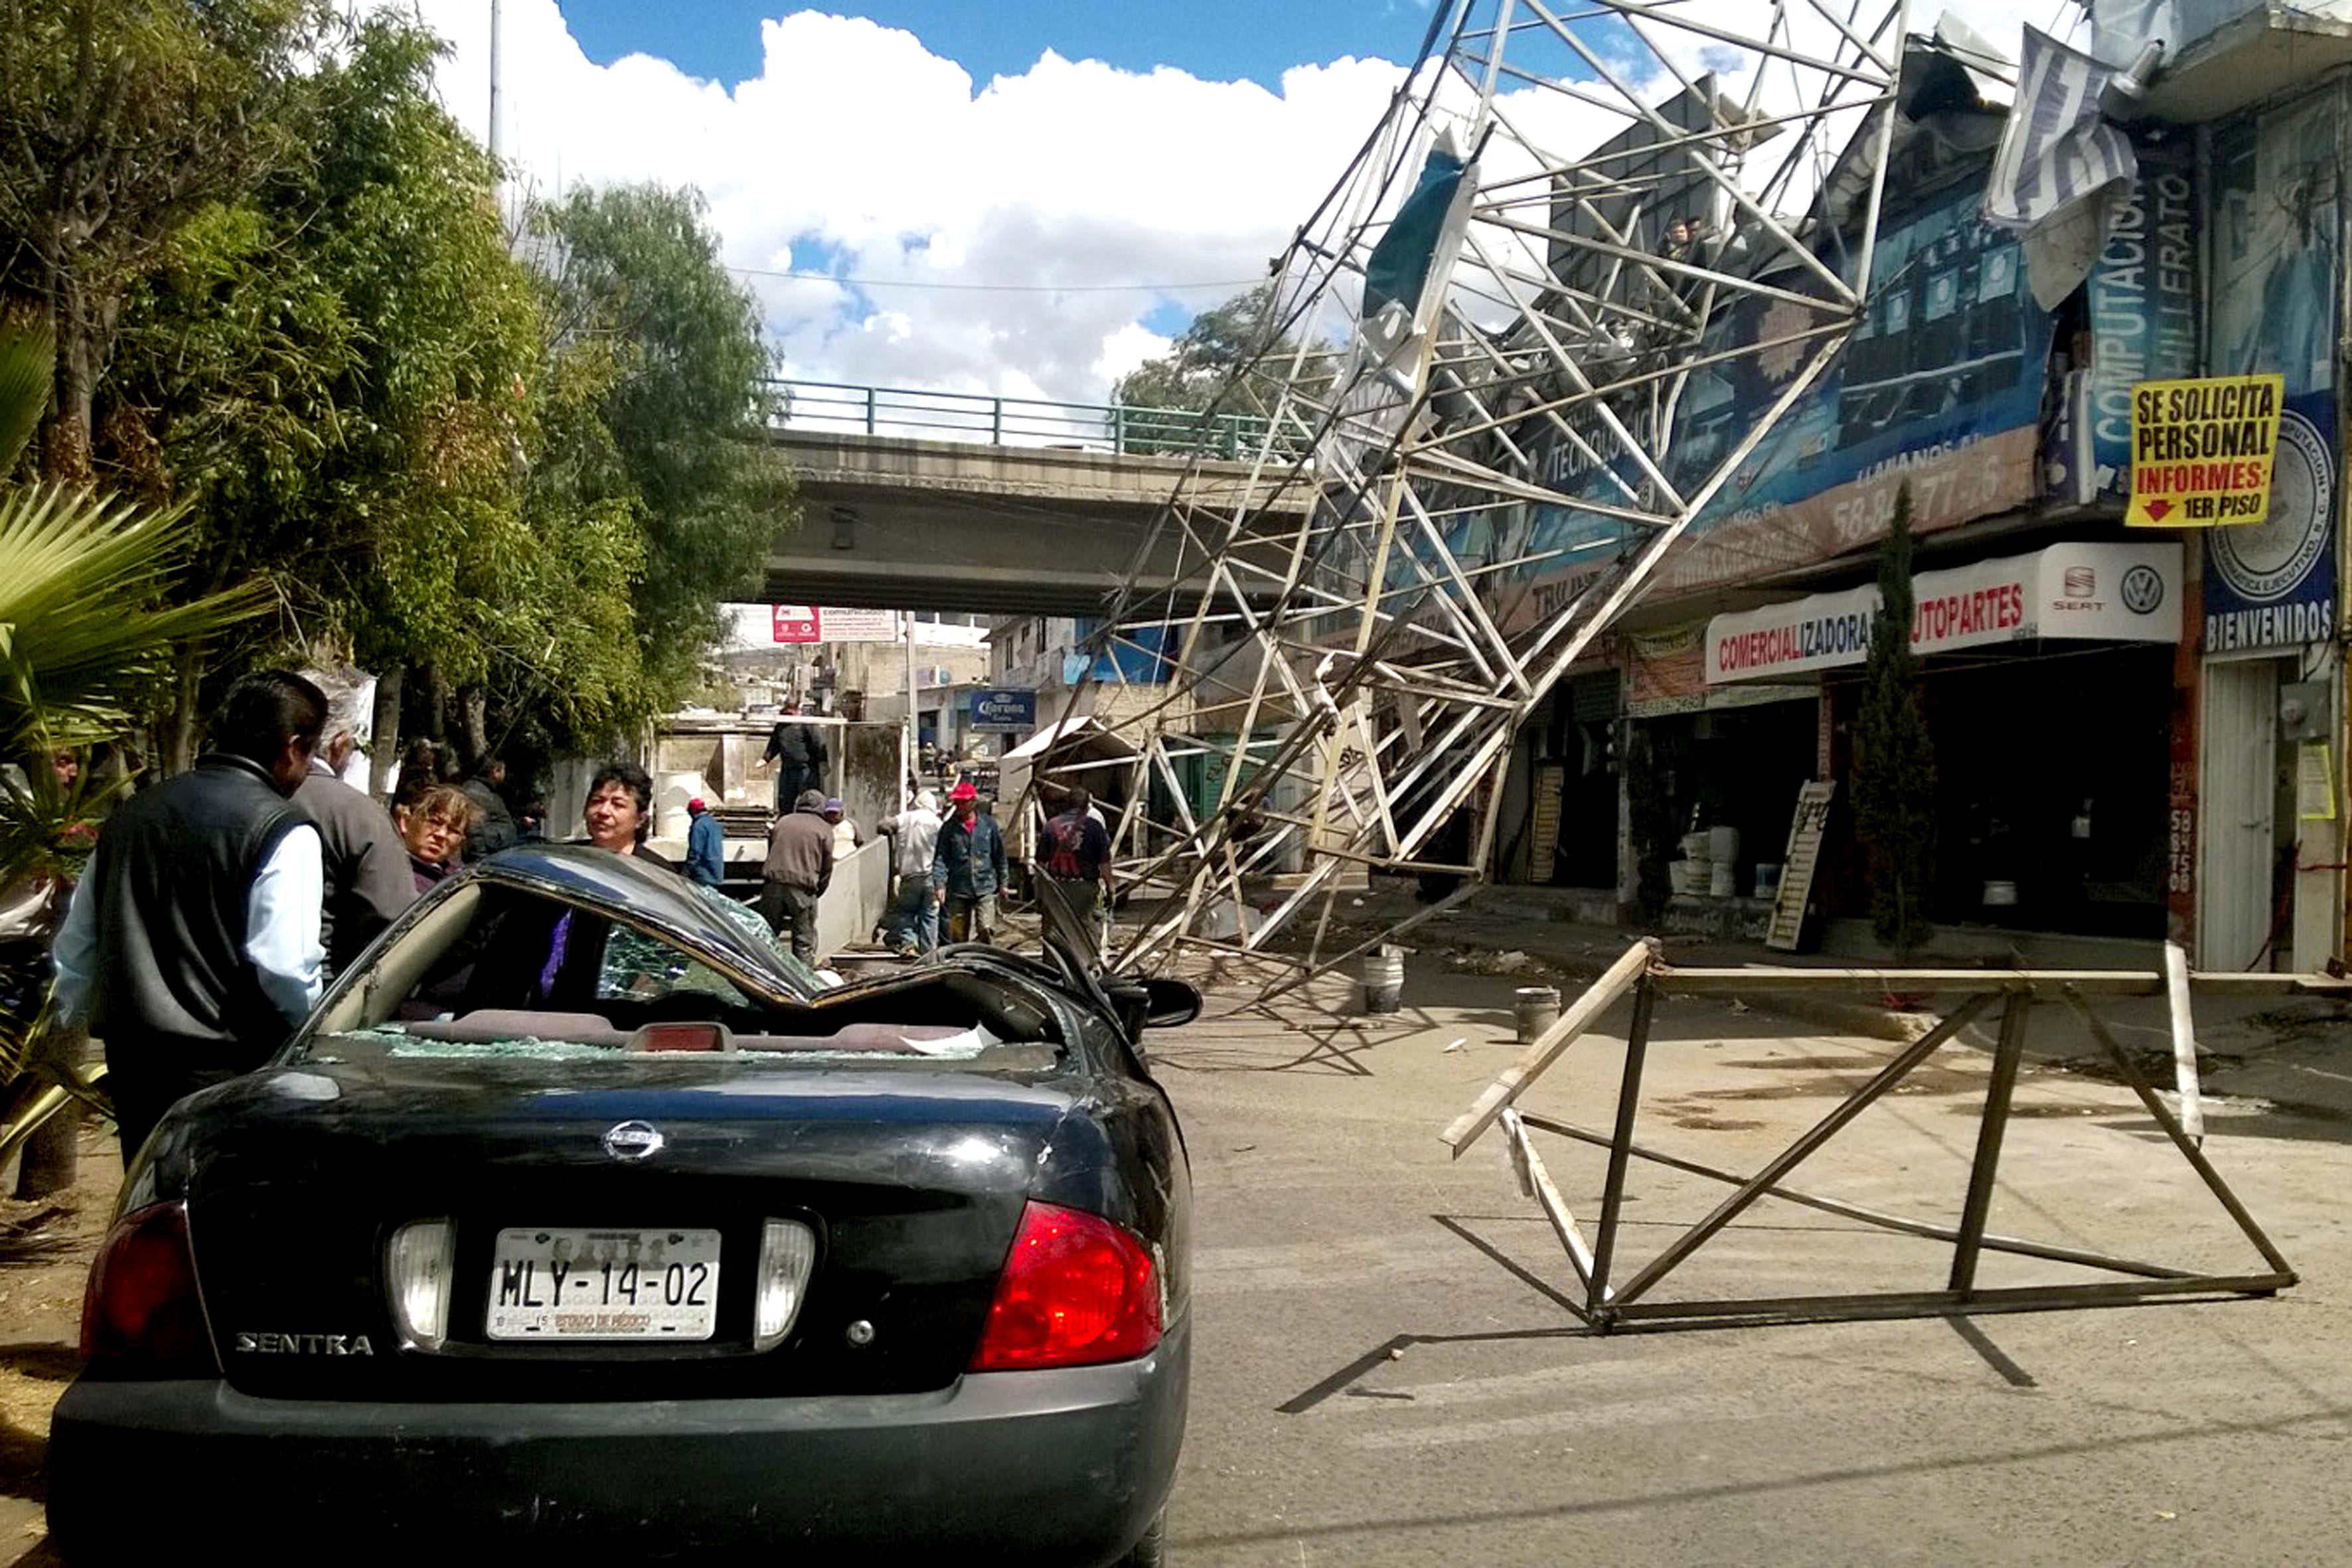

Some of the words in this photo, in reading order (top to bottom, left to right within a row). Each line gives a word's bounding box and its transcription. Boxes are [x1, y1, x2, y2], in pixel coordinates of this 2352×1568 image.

[2157, 173, 2193, 375] HILLERATO
[2137, 389, 2163, 424] SE
[2168, 384, 2274, 421] SOLICITA
[2138, 421, 2270, 461] PERSONAL
[2137, 461, 2267, 494] INFORMES:
[2184, 498, 2215, 519] 1ER
[2218, 494, 2261, 517] PISO
[1718, 611, 1869, 671] COMERCIALIZADORA
[1909, 583, 2023, 643] UTOPARTES
[2205, 599, 2333, 653] BIENVENIDOS
[979, 700, 1025, 716] Corona
[499, 1260, 709, 1306] MLY-14-02
[235, 1332, 374, 1356] SENTRA
